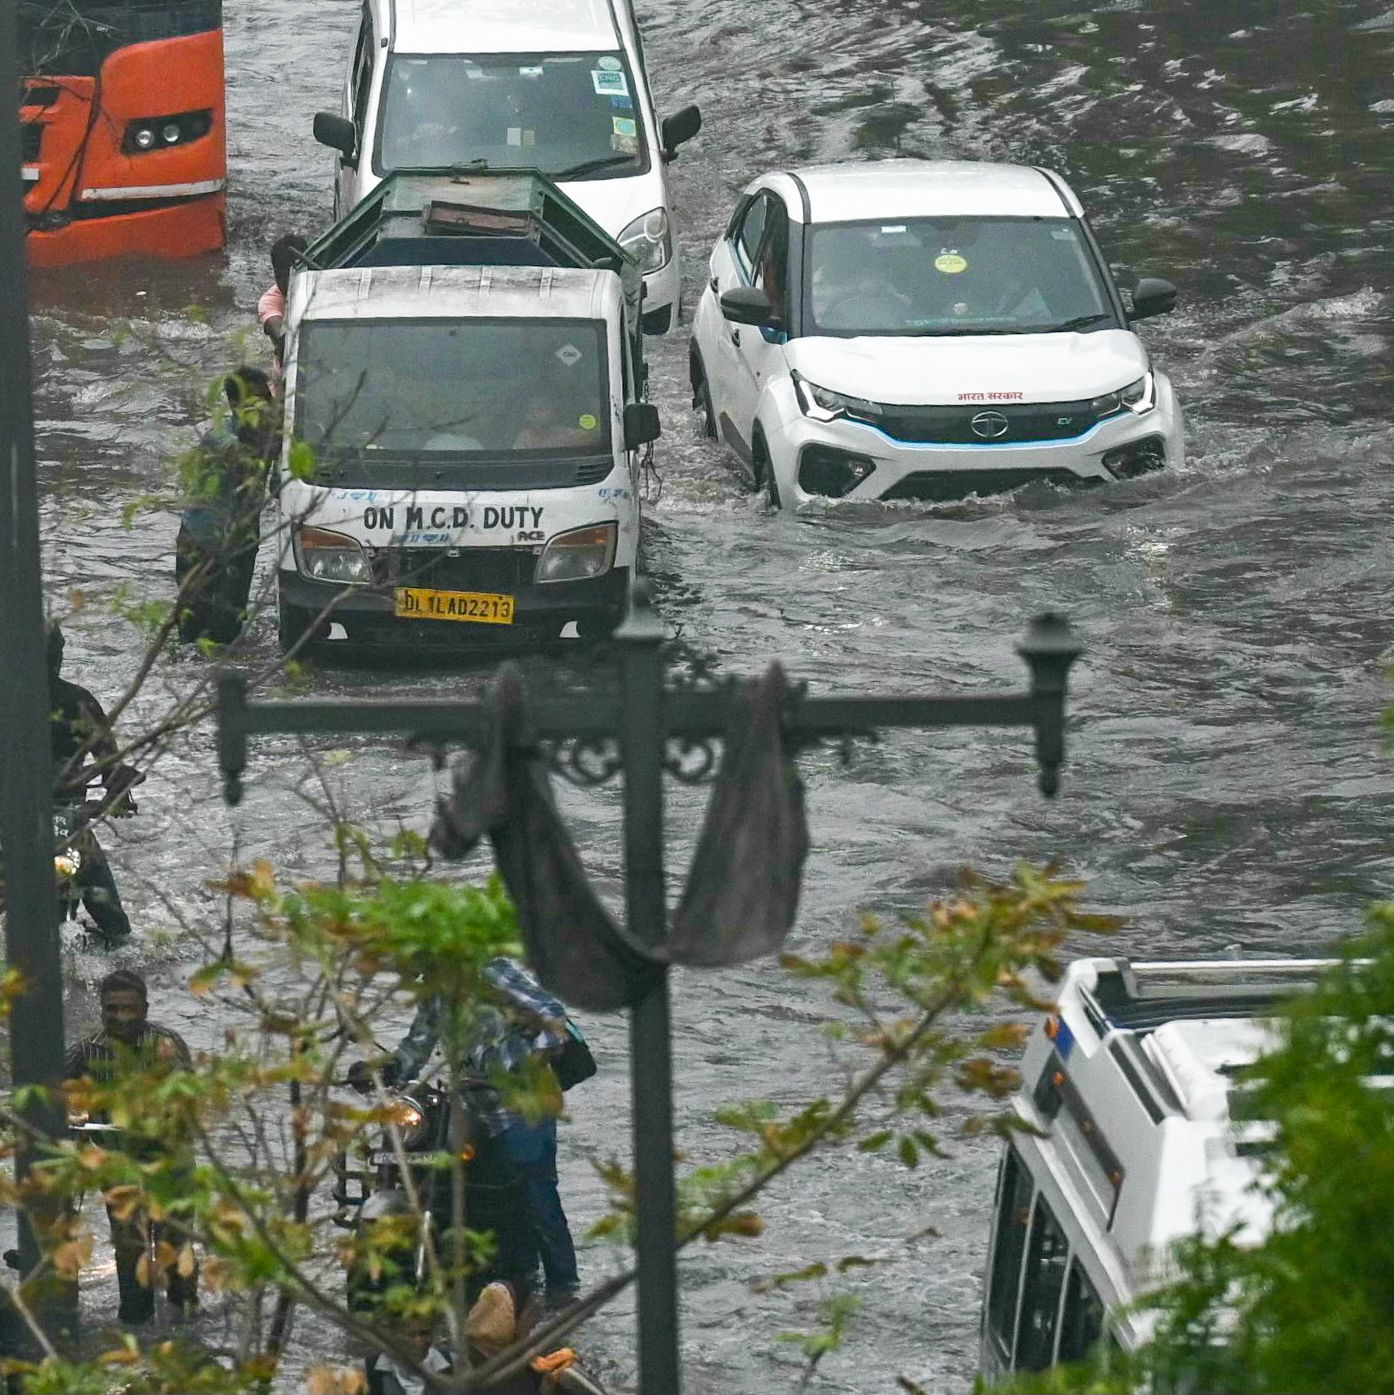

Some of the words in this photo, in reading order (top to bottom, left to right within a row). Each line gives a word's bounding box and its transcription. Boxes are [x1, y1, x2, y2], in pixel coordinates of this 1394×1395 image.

[957, 392, 985, 401] भारत
[988, 391, 1023, 400] सरकार
[1057, 417, 1072, 425] EV
[363, 507, 394, 530] ON
[406, 507, 475, 530] M.C.D.
[483, 507, 544, 530] DUTY
[517, 531, 546, 542] ACE
